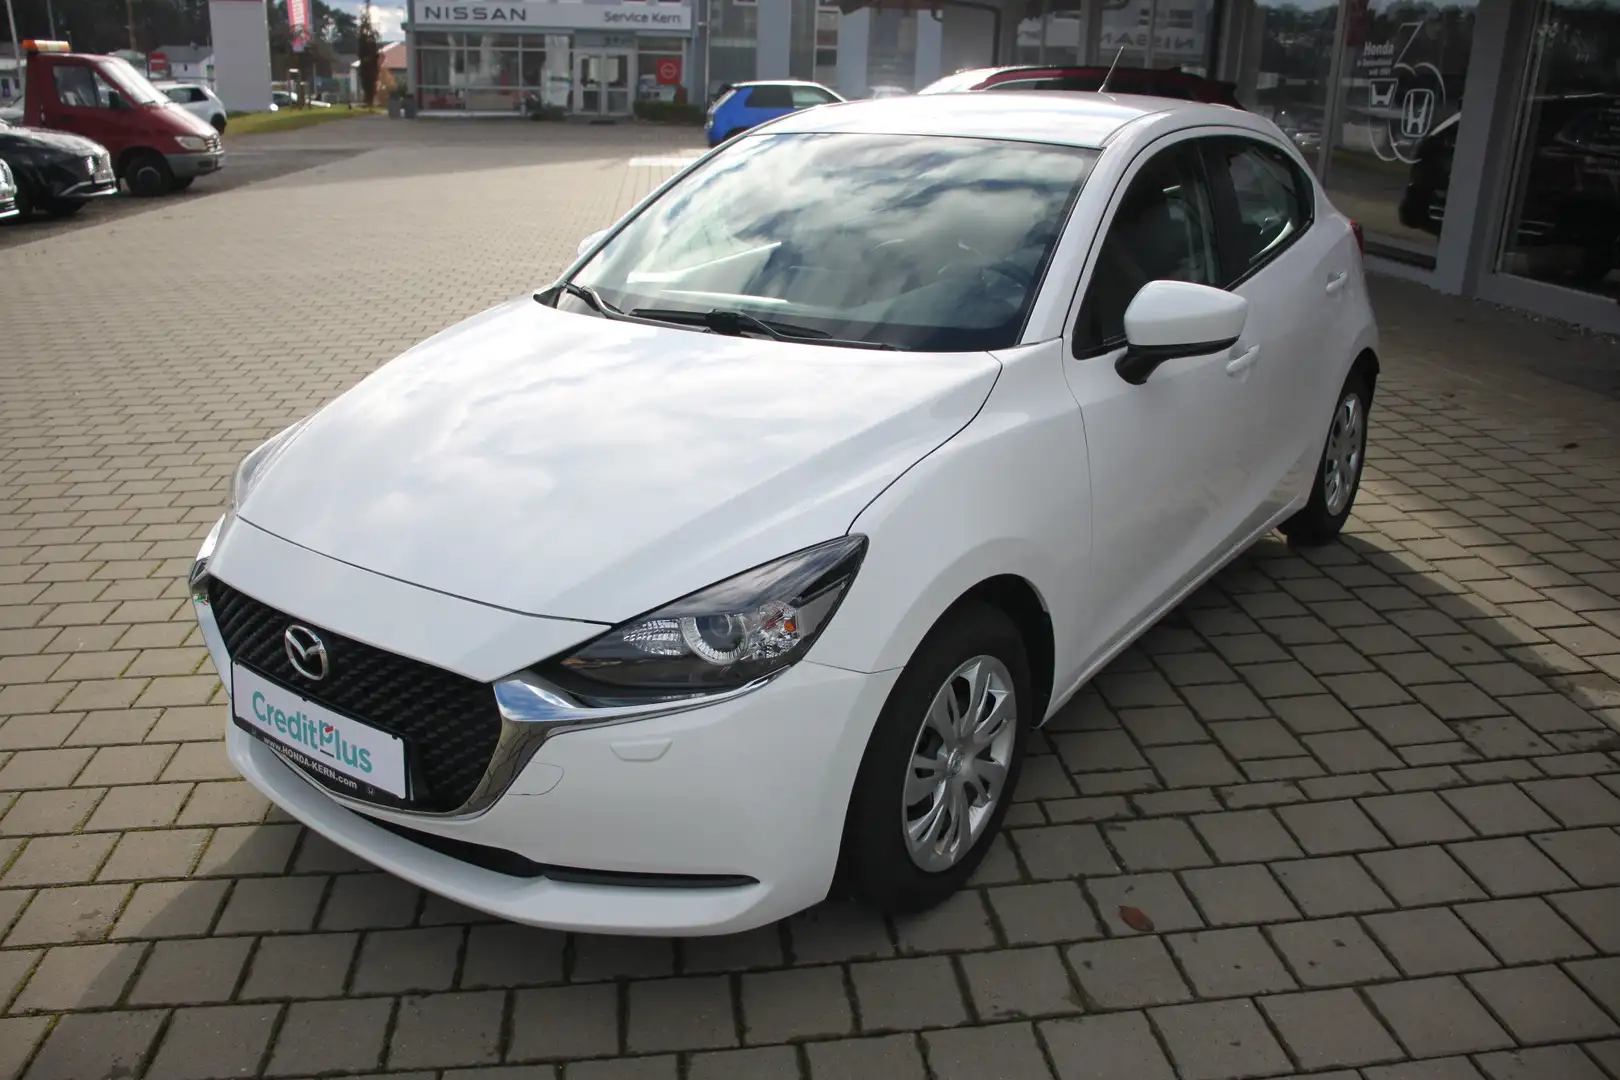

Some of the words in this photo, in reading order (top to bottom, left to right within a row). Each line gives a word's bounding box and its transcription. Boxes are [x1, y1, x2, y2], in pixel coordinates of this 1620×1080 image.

[424, 6, 526, 21] NISSAN
[604, 11, 649, 22] Service
[652, 12, 681, 23] Kern
[1363, 40, 1394, 56] Honda
[252, 691, 373, 774] CreditPlus
[263, 737, 358, 790] www.HONDA-KERN.com
